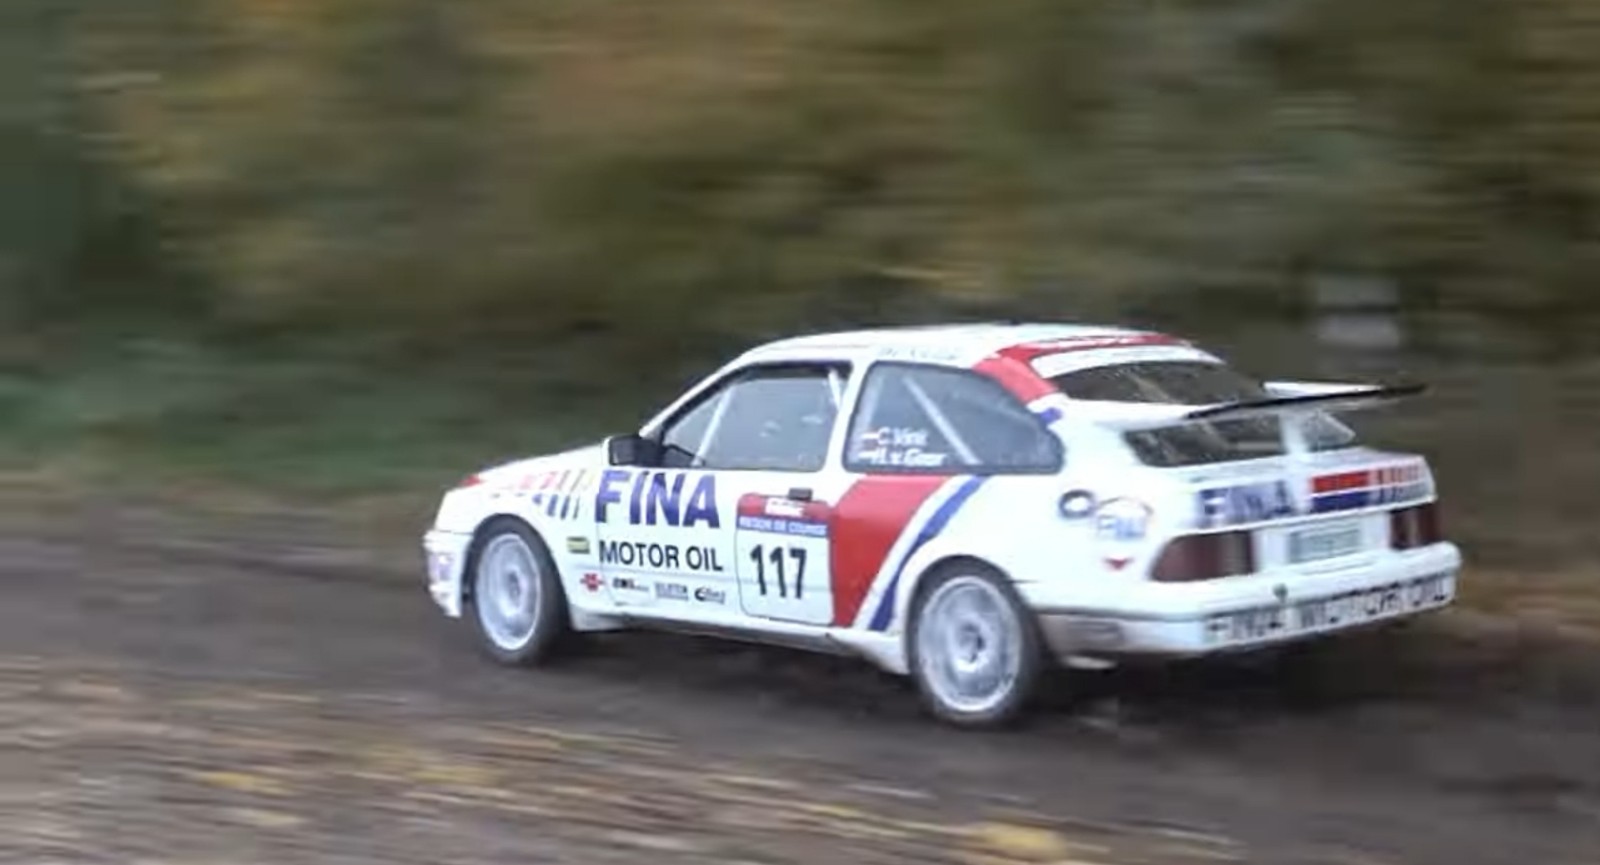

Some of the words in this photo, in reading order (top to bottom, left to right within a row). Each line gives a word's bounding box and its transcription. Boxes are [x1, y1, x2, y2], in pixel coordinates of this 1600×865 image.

[595, 470, 720, 529] FINA
[599, 540, 679, 569] MOTOR
[685, 546, 724, 573] OIL
[750, 544, 808, 600] 117
